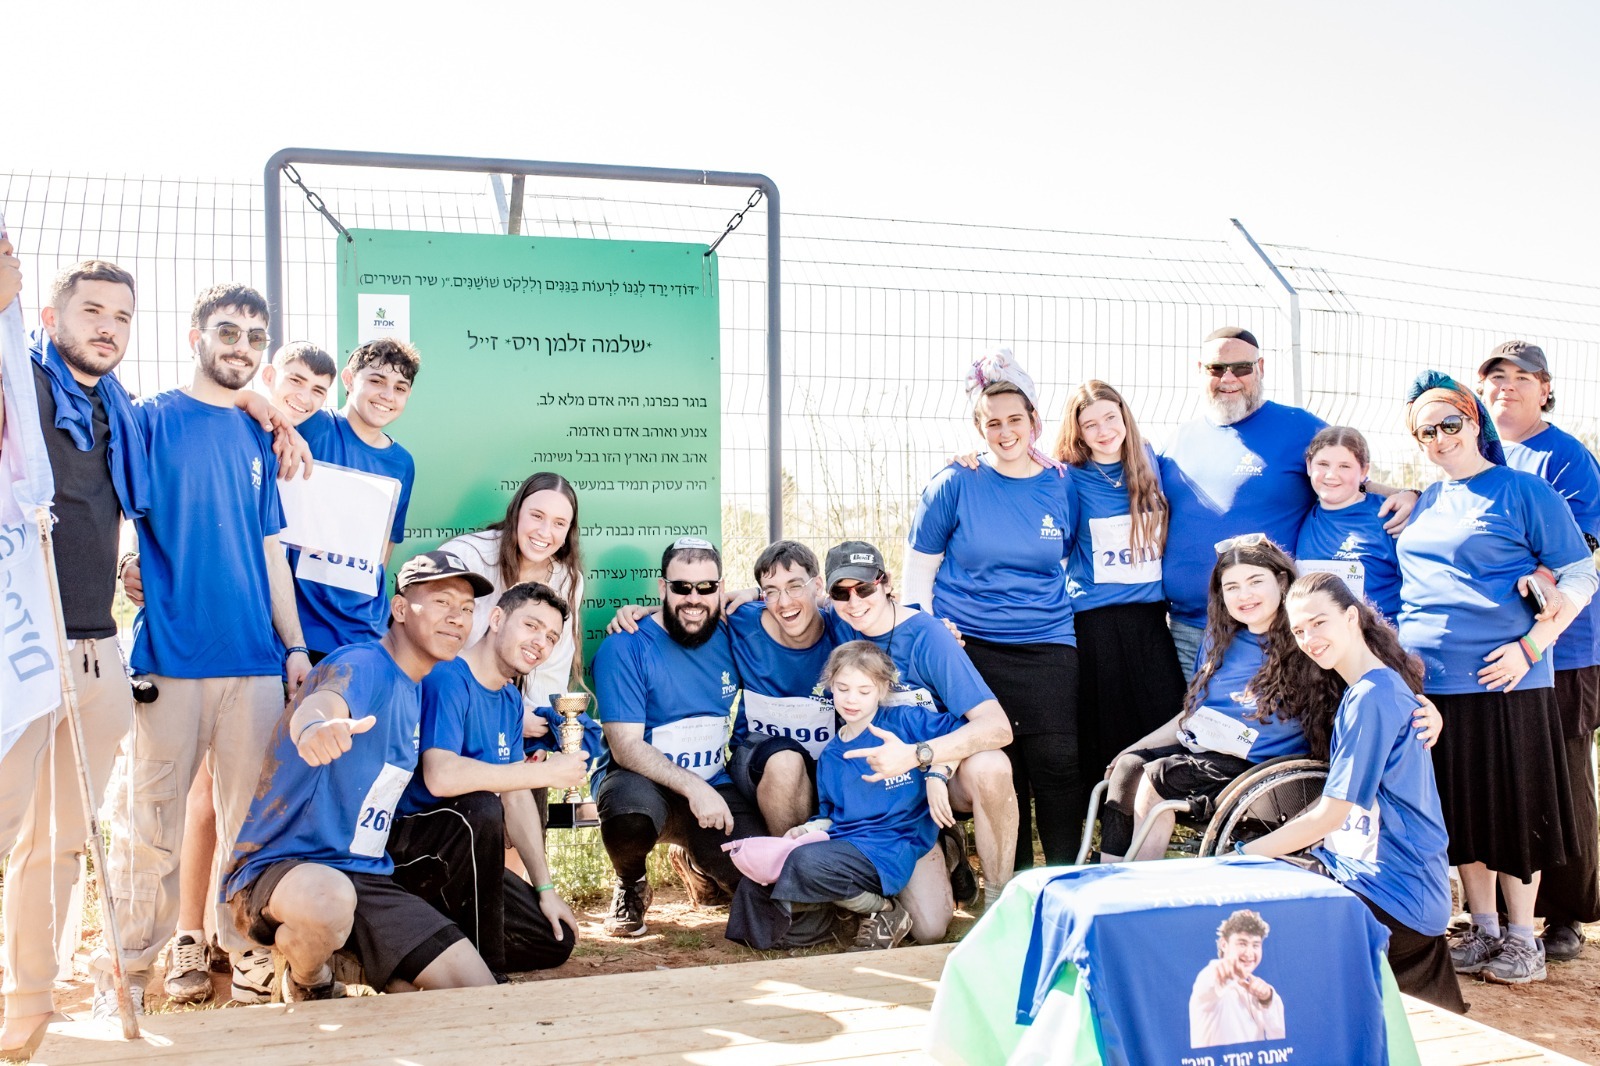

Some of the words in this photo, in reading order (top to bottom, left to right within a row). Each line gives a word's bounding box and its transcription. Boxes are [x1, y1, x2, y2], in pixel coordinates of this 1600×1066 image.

[415, 275, 438, 286] שיר
[545, 332, 587, 356] זלמן
[536, 391, 555, 406] לב,
[558, 392, 585, 406] מלא
[588, 395, 615, 407] אדם
[618, 395, 640, 407] היה
[682, 396, 708, 408] בוגר
[566, 425, 610, 438] ואדמה.
[613, 426, 640, 437] אדם
[641, 426, 678, 438] ואוהב
[680, 426, 708, 438] צנוע
[530, 451, 573, 463] נשימה.
[575, 449, 600, 463] בכל
[602, 451, 622, 463] הזו
[624, 451, 658, 465] הארץ
[660, 452, 679, 463] את
[682, 452, 708, 463] אהב
[573, 479, 615, 490] במעשי
[619, 479, 649, 490] תמיד
[652, 479, 683, 493] עסוק
[685, 479, 708, 490] היה
[606, 526, 635, 537] נבנה
[638, 525, 661, 536] הזה
[664, 525, 708, 536] המצפה
[752, 719, 830, 743] 26196
